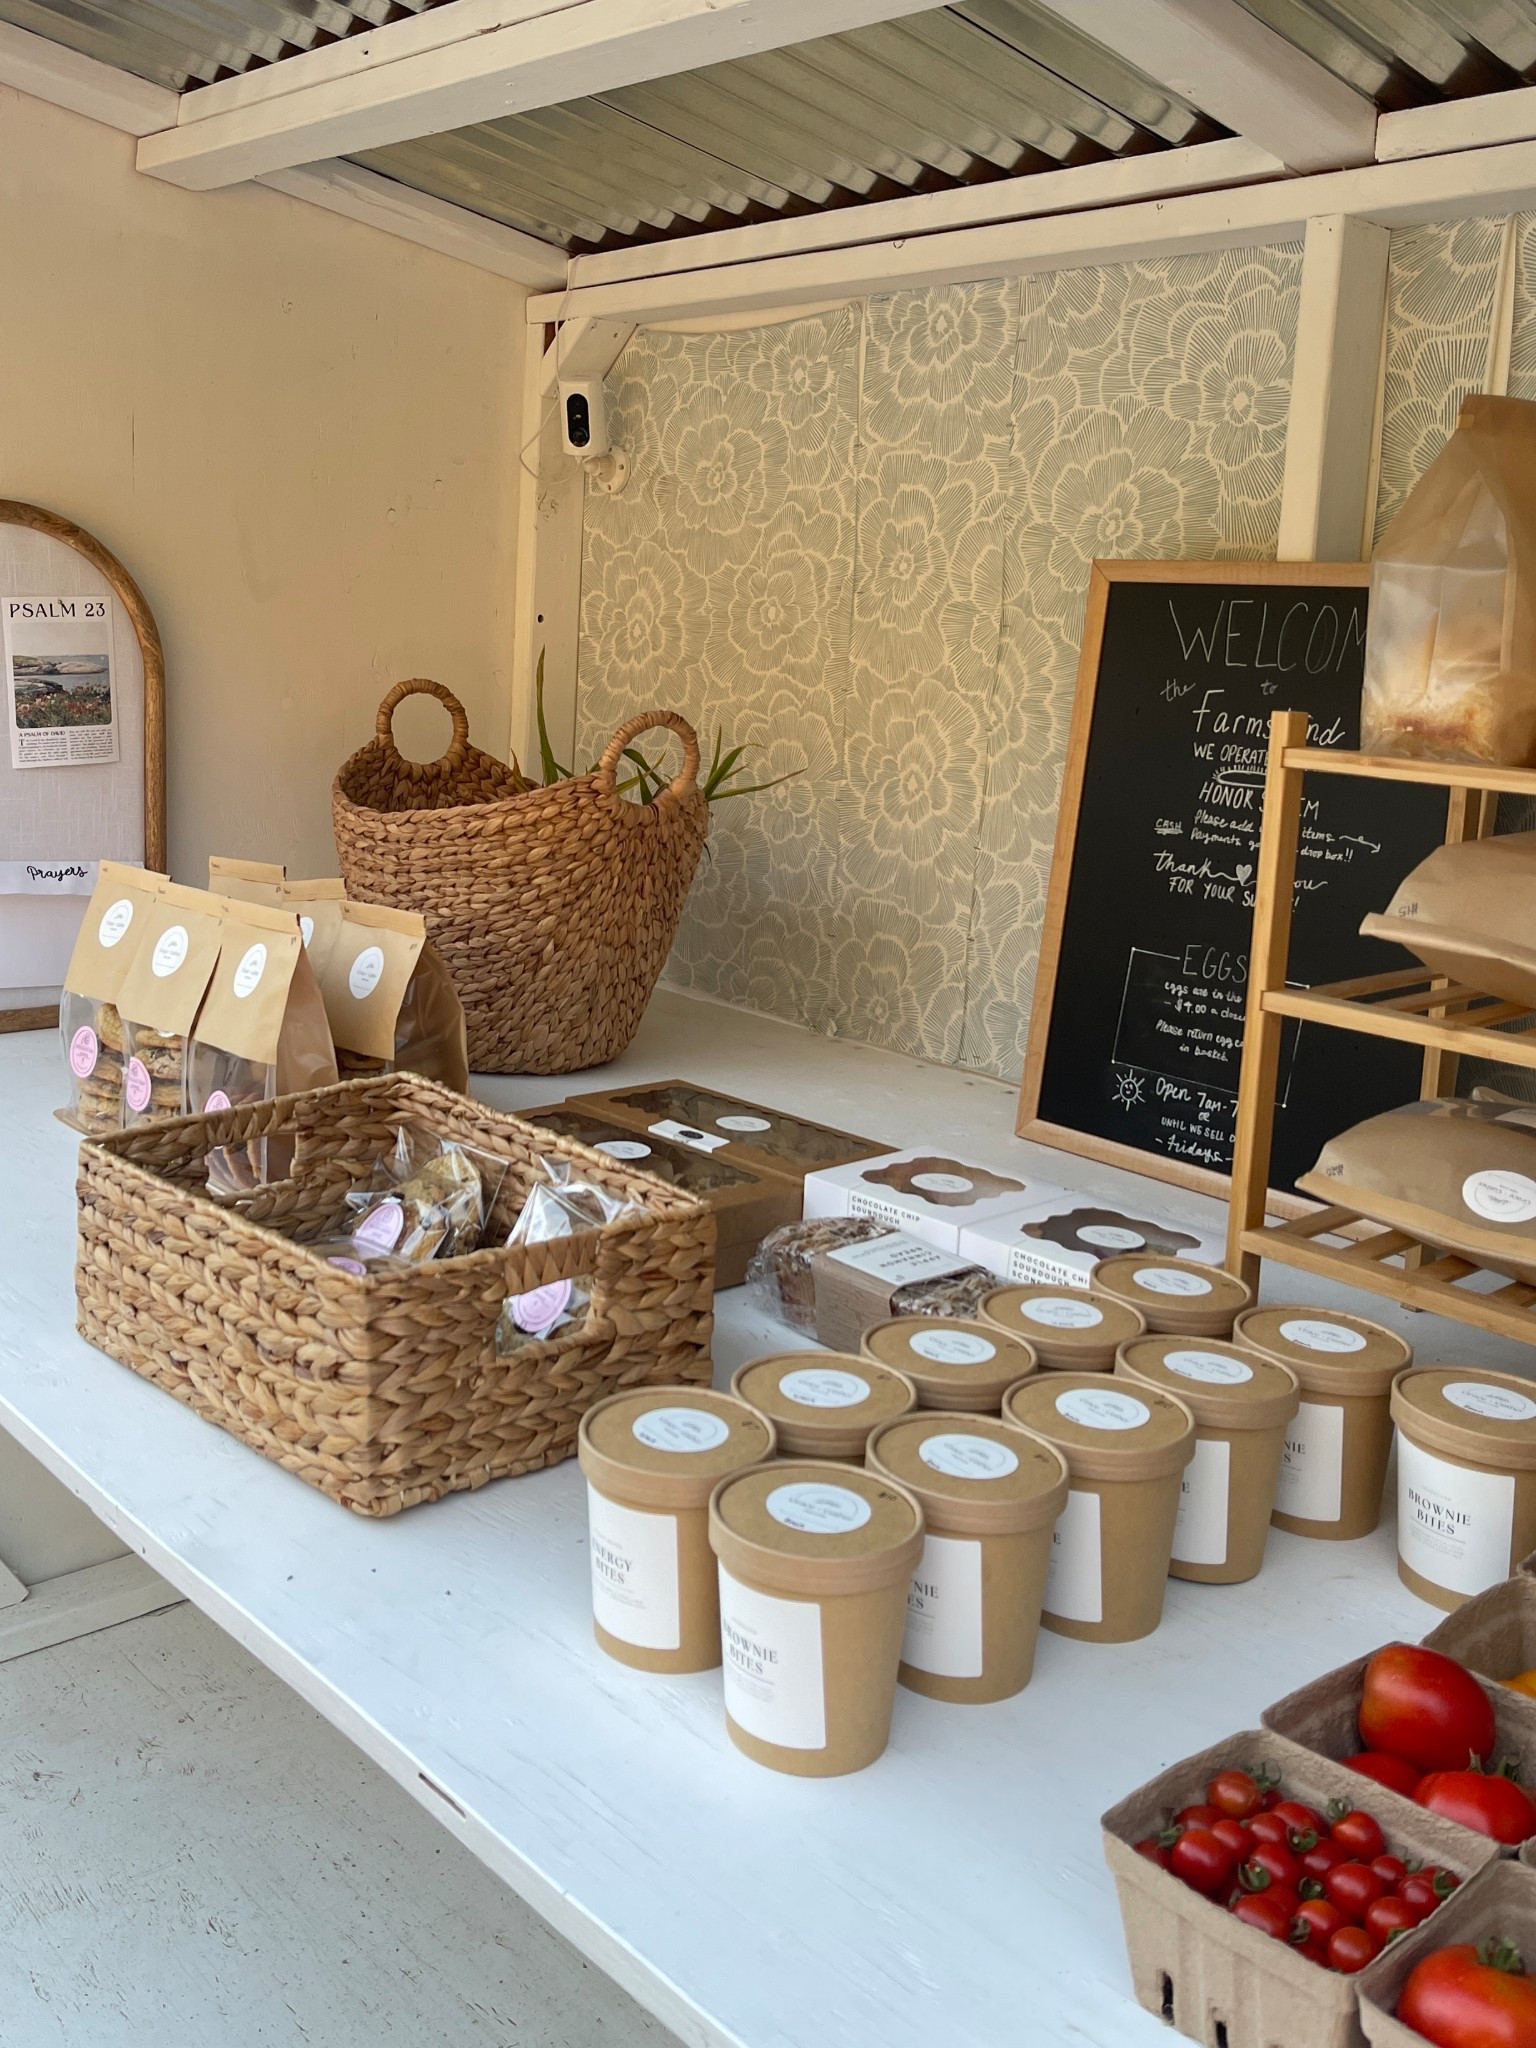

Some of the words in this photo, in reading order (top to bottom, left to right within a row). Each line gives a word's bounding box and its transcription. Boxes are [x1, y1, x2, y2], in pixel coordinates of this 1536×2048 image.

[10, 602, 76, 618] PSALM
[84, 602, 106, 617] 23
[1168, 599, 1368, 675] WELCOM
[1159, 678, 1197, 702] the
[1260, 679, 1278, 695] to
[1192, 688, 1346, 746] Farmsnd
[1193, 742, 1214, 760] WE
[1199, 781, 1253, 810] HONOR
[1155, 818, 1182, 830] CASH
[1194, 809, 1229, 827] Please
[1229, 819, 1254, 833] add
[1302, 827, 1335, 842] items
[1190, 827, 1242, 847] Payments
[1301, 846, 1323, 860] drop
[26, 865, 88, 882] Prayers
[1293, 879, 1328, 890] ou
[1169, 876, 1194, 895] FOR
[1204, 883, 1235, 903] YOUR
[1182, 944, 1247, 984] EGGS
[1164, 981, 1189, 997] eggs
[1192, 987, 1209, 998] are
[1212, 988, 1224, 1000] in
[1226, 990, 1243, 1004] the
[1155, 1018, 1184, 1036] Please
[1187, 1028, 1213, 1042] return
[1215, 1034, 1234, 1049] egg
[1178, 1043, 1190, 1053] in
[1155, 1077, 1192, 1102] Open
[1160, 1116, 1187, 1131] UNTIL
[1189, 1123, 1203, 1136] WE
[1203, 1127, 1225, 1141] SELL
[851, 1195, 899, 1216] CHOCOLATE
[900, 1211, 921, 1222] CHIP
[851, 1204, 900, 1226] SOURDOUGH
[1013, 1251, 1068, 1277] CHOCOLATE
[1071, 1273, 1088, 1285] CHI
[1013, 1260, 1070, 1287] SOURDOUGH
[1408, 1487, 1472, 1527] BROWNIE
[1417, 1508, 1455, 1535] BITES
[595, 1555, 625, 1585] BITES
[723, 1617, 779, 1665] BROWNIE
[729, 1643, 764, 1675] BITES
